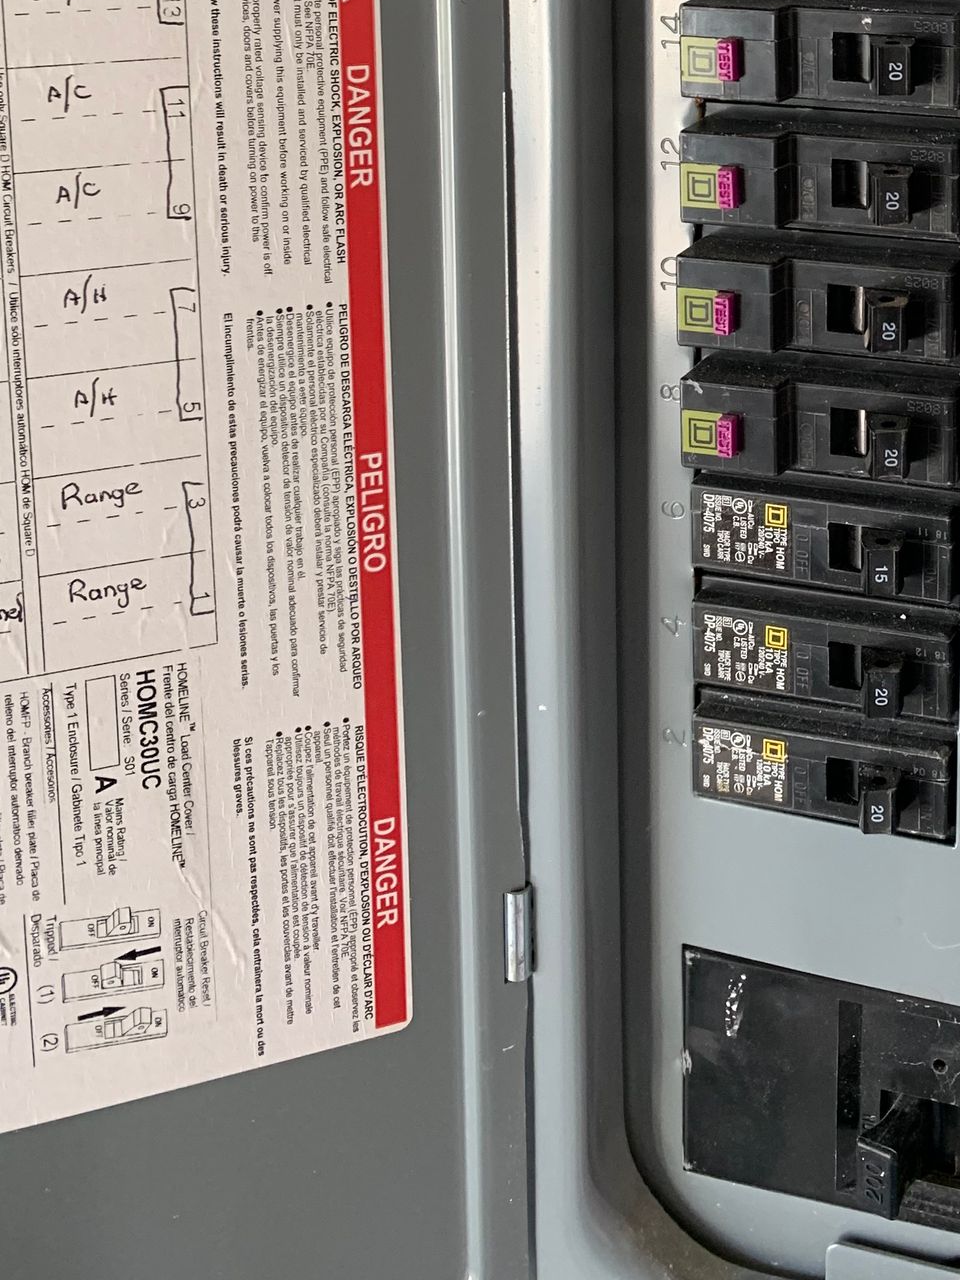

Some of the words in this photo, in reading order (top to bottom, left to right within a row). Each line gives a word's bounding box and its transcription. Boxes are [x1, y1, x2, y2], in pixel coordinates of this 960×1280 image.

[328, 12, 339, 66] ELECTRIC
[719, 43, 732, 80] TEST
[888, 62, 902, 80] 20
[48, 75, 91, 113] A/C
[330, 70, 339, 111] SHOCK,
[167, 98, 185, 118] 11
[346, 64, 373, 189] DANGER
[331, 114, 342, 180] EXPLOSION,
[56, 172, 101, 209] A/C
[334, 184, 344, 199] OR
[719, 172, 731, 208] TEST
[886, 192, 899, 210] 20
[173, 204, 190, 215] 9
[335, 202, 344, 225] ARC
[336, 229, 346, 264] FLASH
[178, 303, 196, 312] 7
[714, 300, 729, 334] TEST
[882, 322, 895, 341] 20
[184, 402, 200, 412] 5
[718, 423, 731, 456] TEST
[885, 449, 898, 467] 20
[61, 483, 143, 509] Range
[187, 497, 205, 509] 3
[359, 452, 387, 573] PELIGRO
[703, 494, 715, 533] DP-4075
[775, 547, 785, 569] HOM
[875, 565, 888, 582] 15
[69, 578, 147, 608] Range
[193, 592, 210, 600] 1
[704, 614, 715, 652] DP-4075
[120, 673, 132, 707] Series
[163, 665, 175, 699] Frente
[776, 668, 785, 690] HOM
[63, 683, 78, 709] Type
[874, 688, 888, 706] 20
[165, 702, 177, 719] del
[136, 669, 161, 790] HOMC30UC
[166, 721, 177, 753] centro
[68, 722, 81, 775] Enclosure
[180, 734, 192, 760] Load
[124, 756, 136, 776] S01
[168, 756, 178, 769] de
[94, 776, 117, 794] A
[166, 772, 179, 801] carga
[181, 763, 193, 797] Center
[773, 780, 783, 801] HOM
[71, 784, 84, 832] Gabinete
[115, 798, 123, 826] Mains
[183, 800, 194, 829] Cover
[871, 805, 883, 823] 20
[73, 835, 85, 857] Tipo
[116, 828, 126, 857] Rating
[374, 817, 398, 929] DANGER
[147, 917, 156, 927] ON
[38, 984, 56, 1004] (1)
[40, 1033, 58, 1052] (2)
